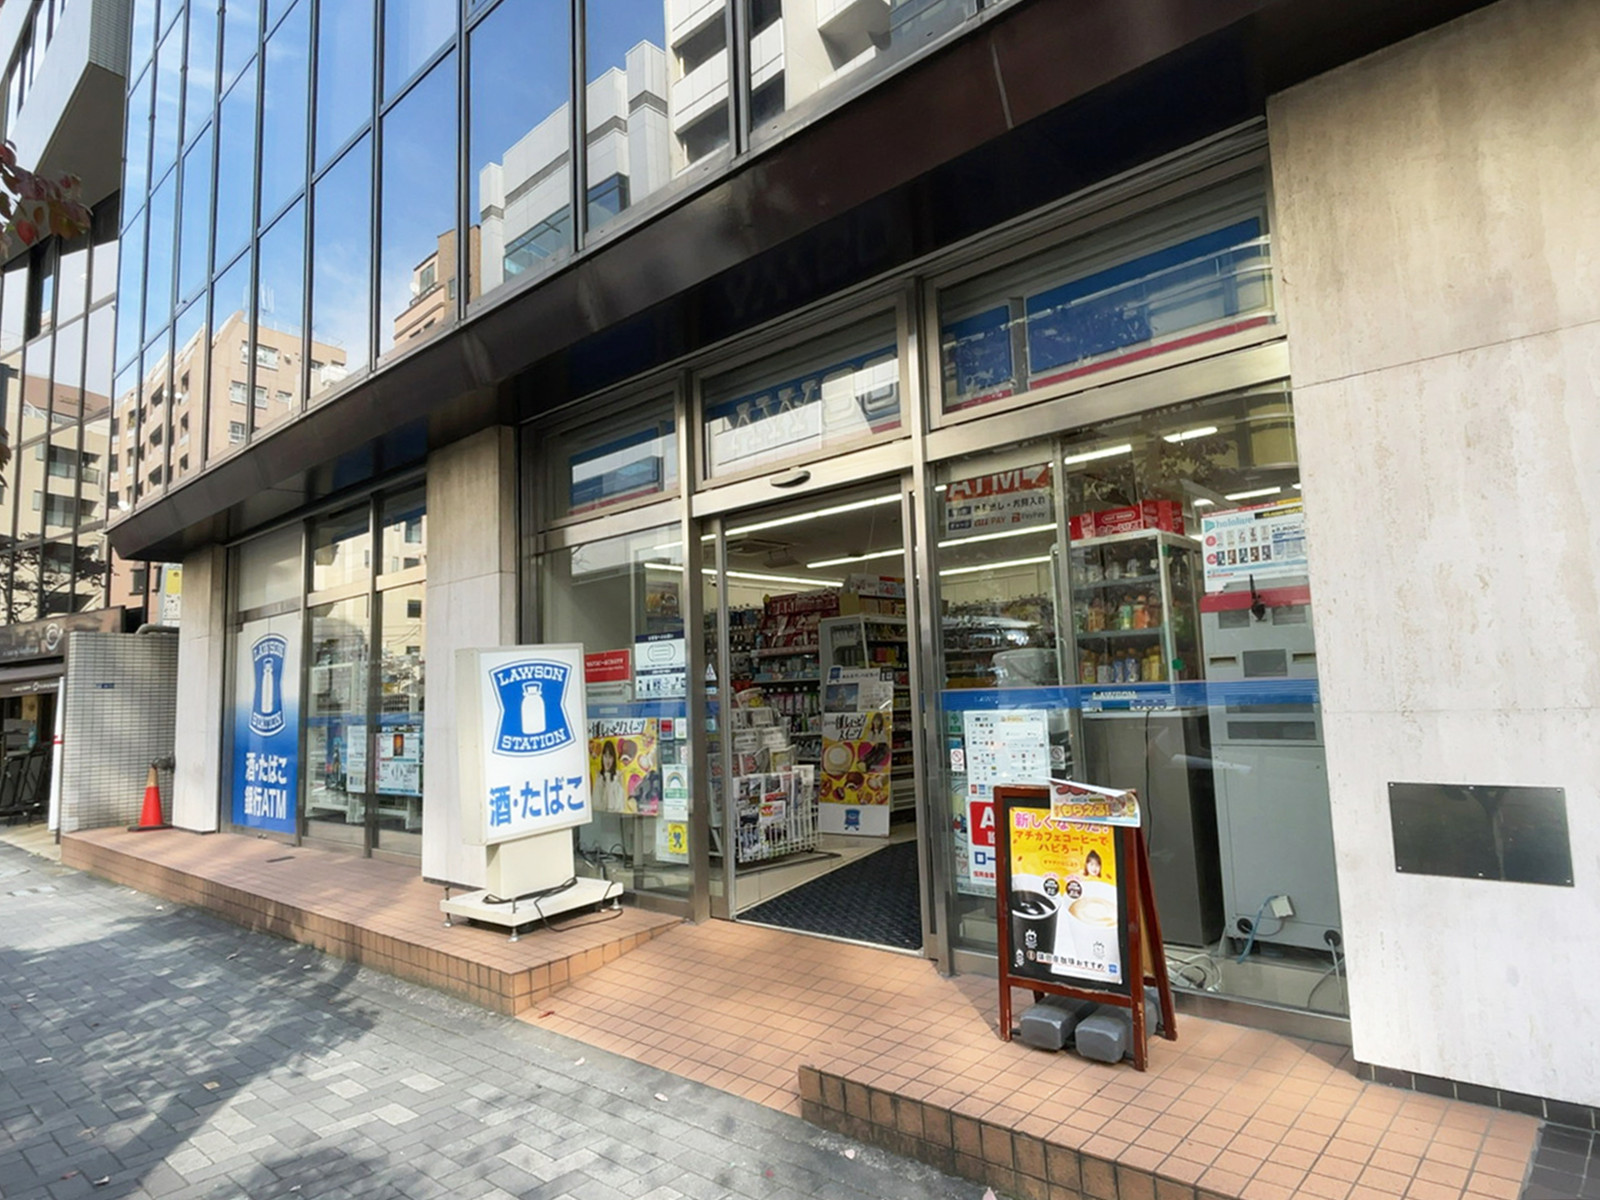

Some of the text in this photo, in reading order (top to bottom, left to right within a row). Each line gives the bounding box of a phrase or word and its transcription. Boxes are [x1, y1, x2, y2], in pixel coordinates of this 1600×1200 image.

[498, 665, 565, 686] LAWSON
[502, 728, 567, 750] STATION
[245, 752, 288, 785] 酒・たばこ
[489, 776, 585, 827] 酒・たばこ
[1015, 830, 1108, 846] マチカフェコーヒーで
